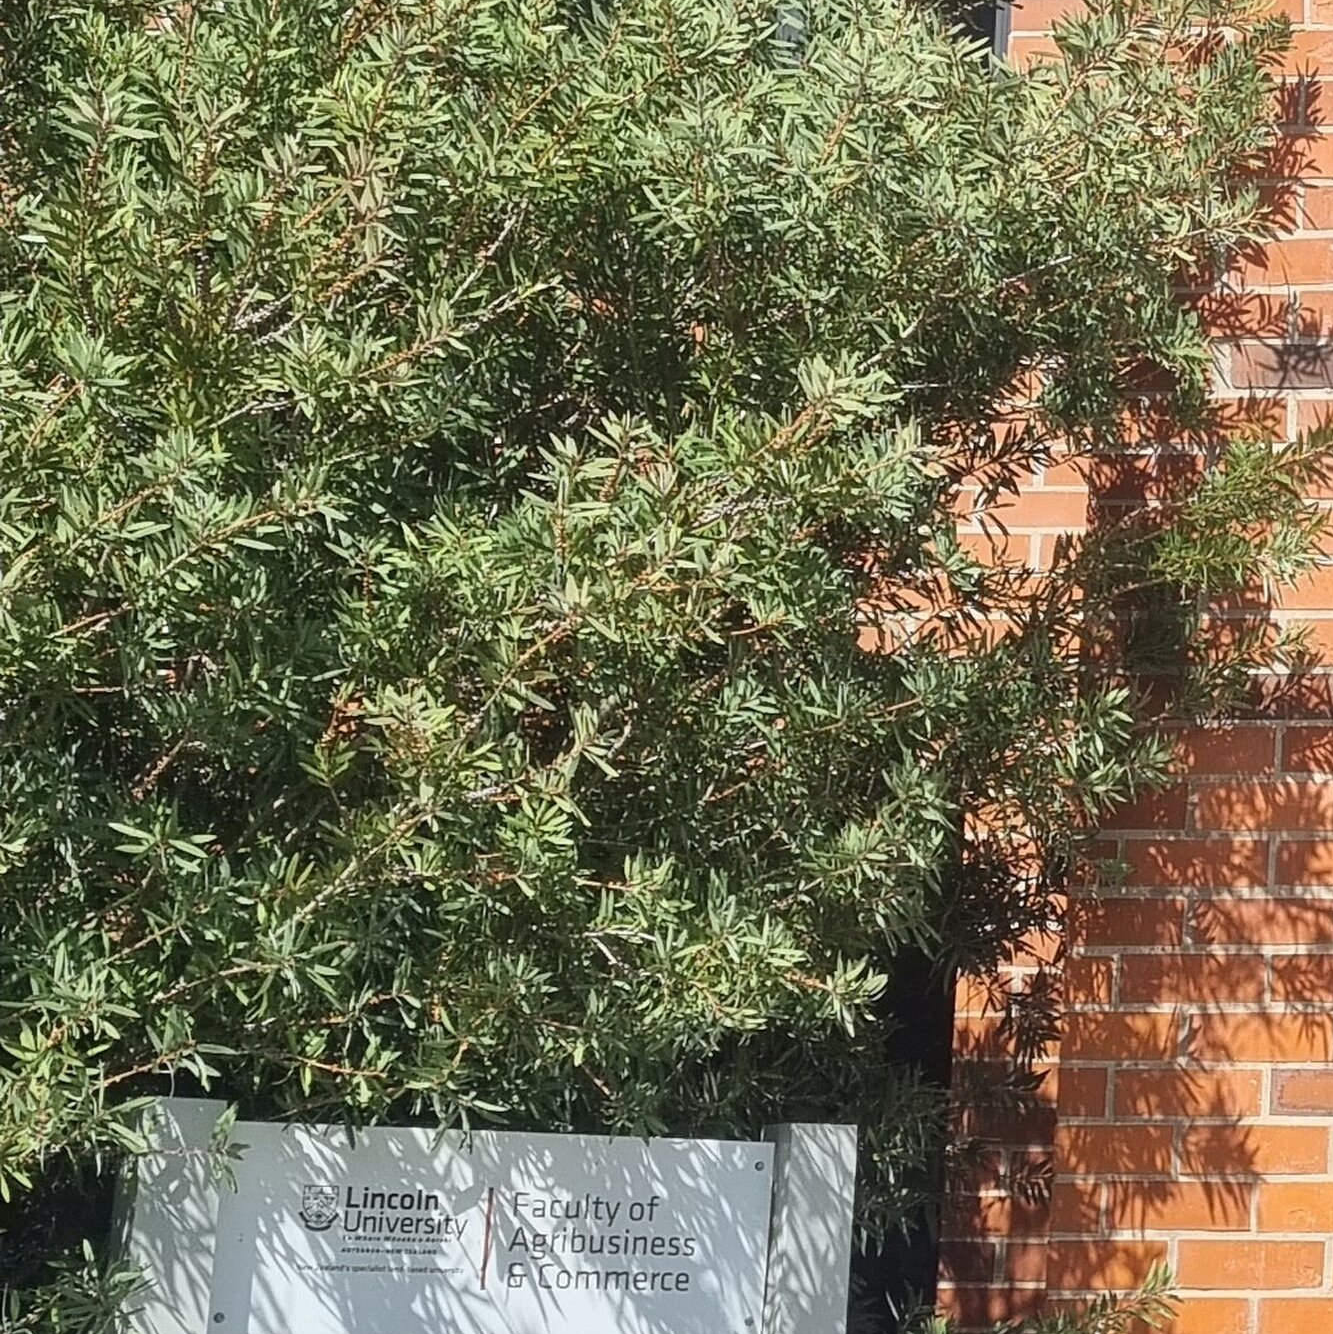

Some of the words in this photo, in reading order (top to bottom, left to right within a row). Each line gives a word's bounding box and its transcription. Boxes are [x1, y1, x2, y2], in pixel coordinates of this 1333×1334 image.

[345, 1186, 439, 1211] Lincoln
[513, 1192, 621, 1227] Faculty
[629, 1195, 660, 1222] of
[343, 1210, 469, 1241] University
[508, 1226, 695, 1260] Agribusiness
[507, 1262, 527, 1288] &
[538, 1263, 689, 1292] Commerce
